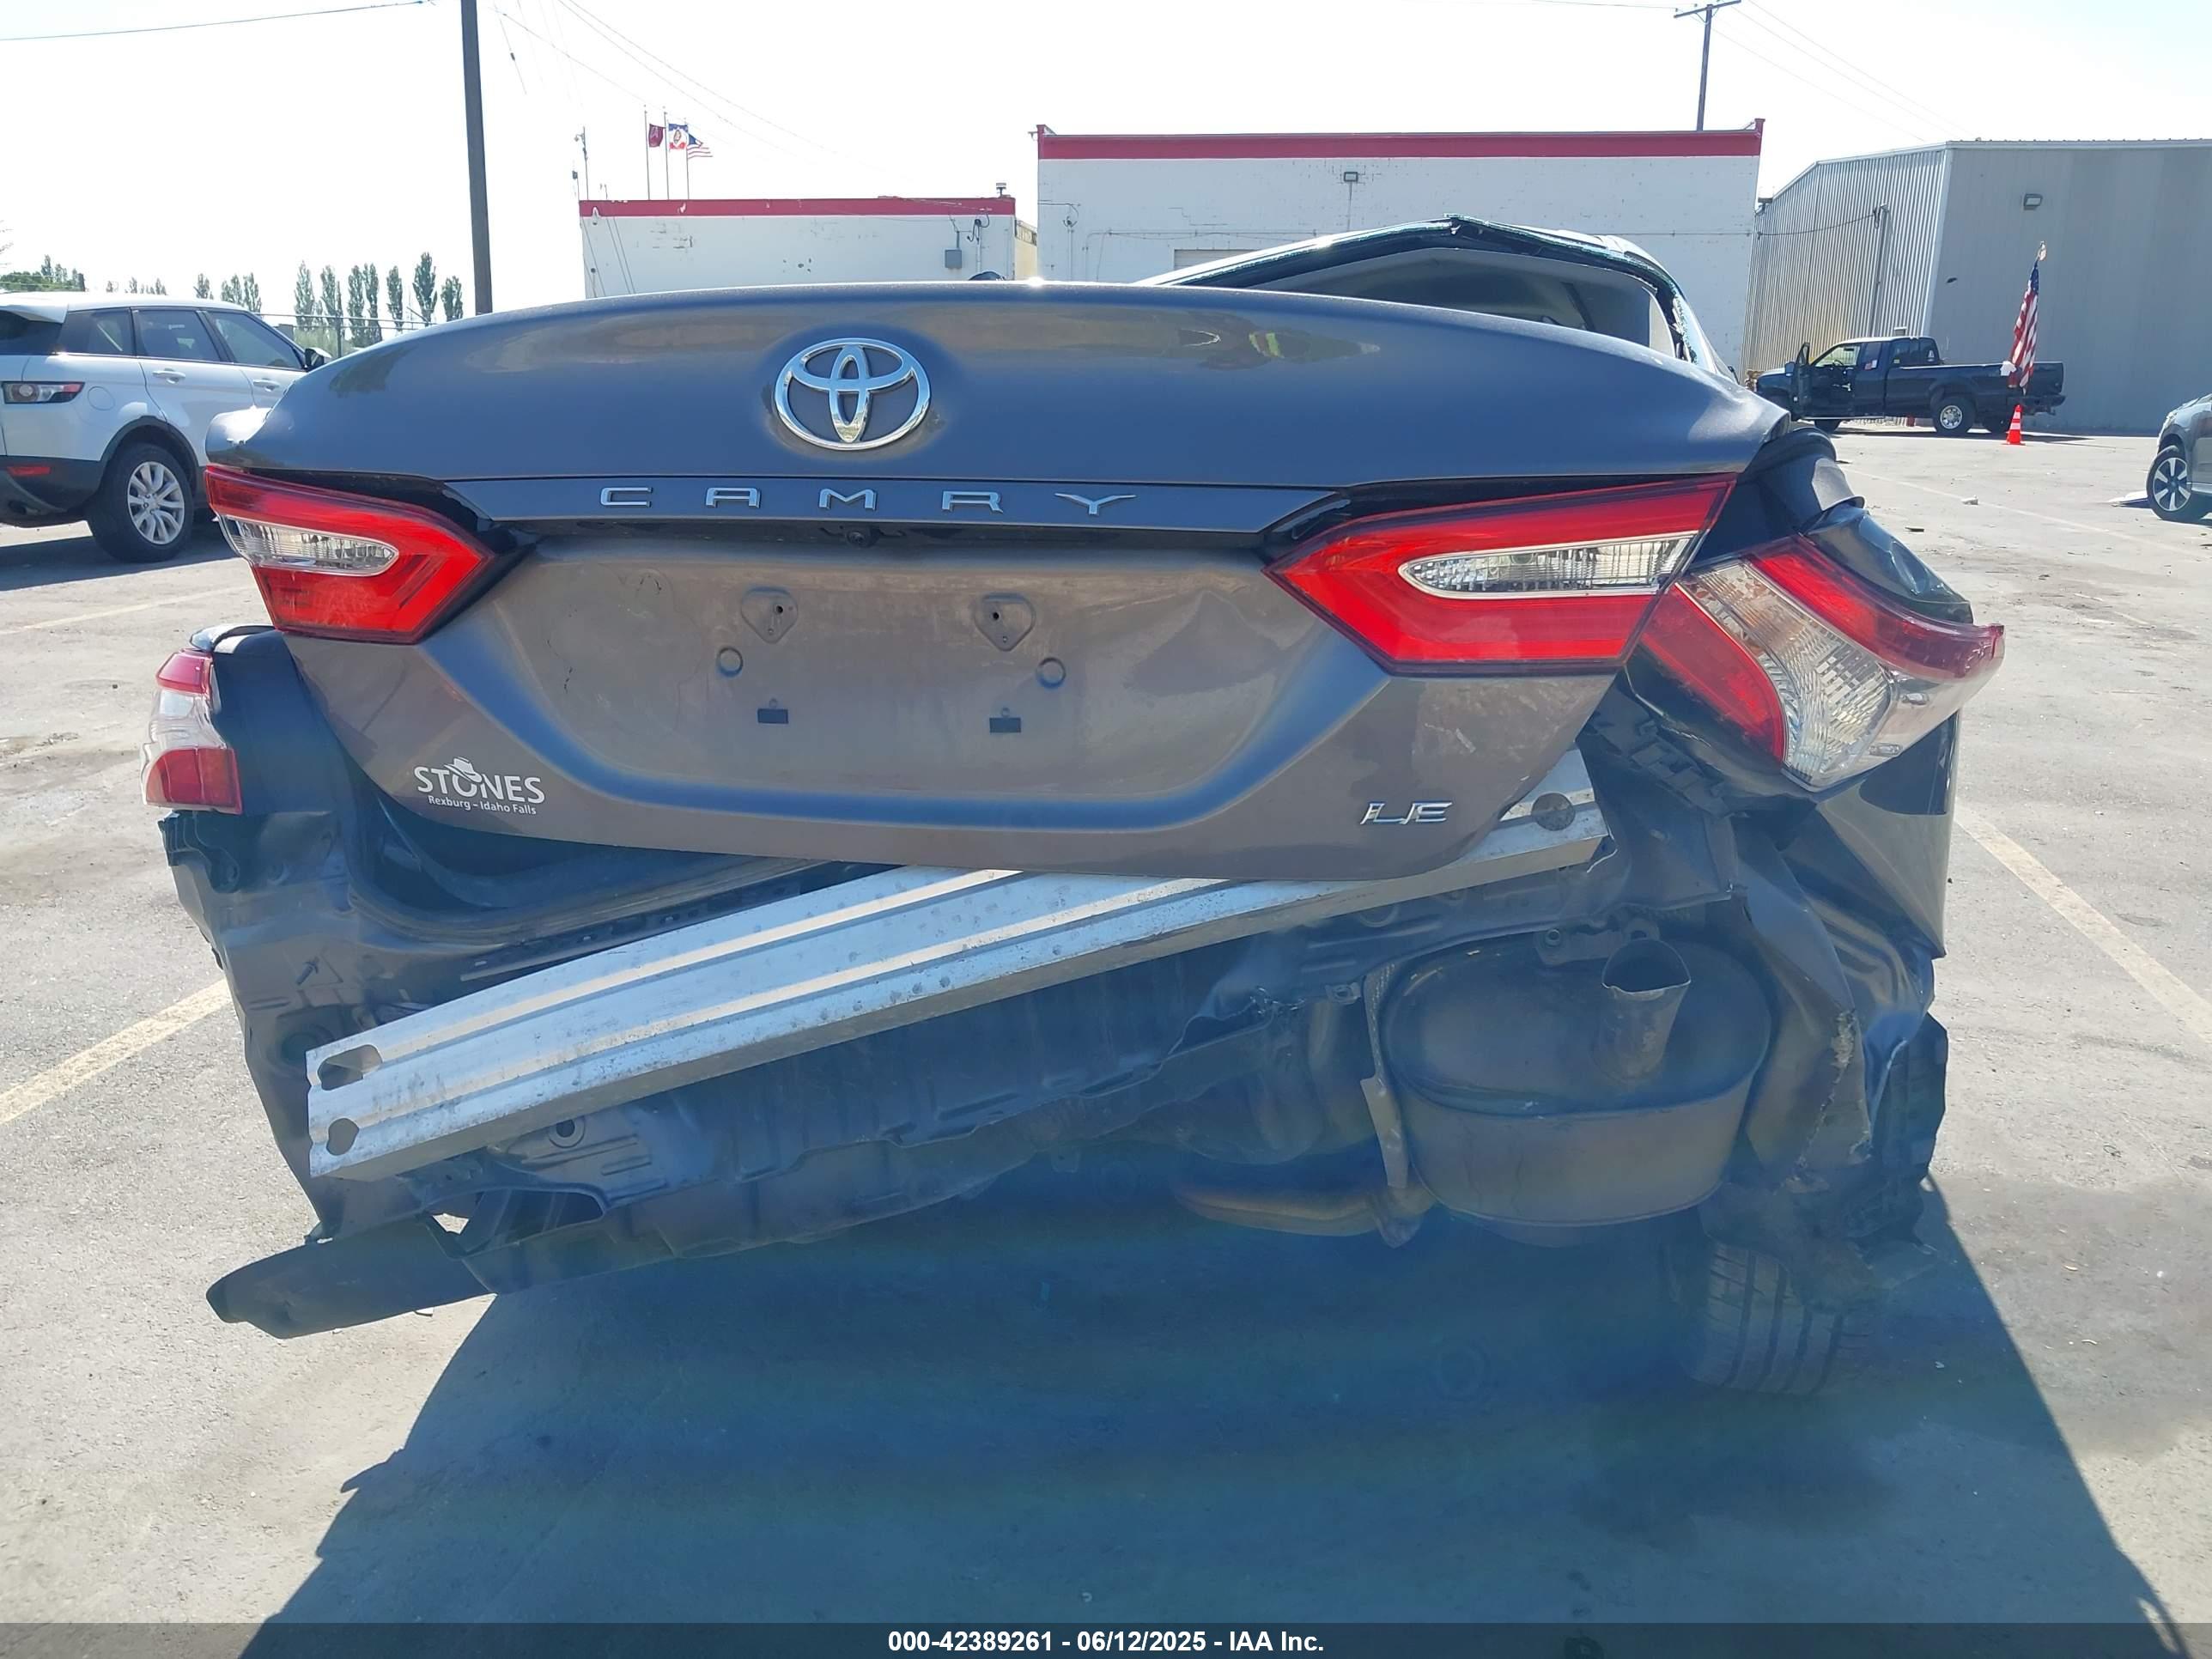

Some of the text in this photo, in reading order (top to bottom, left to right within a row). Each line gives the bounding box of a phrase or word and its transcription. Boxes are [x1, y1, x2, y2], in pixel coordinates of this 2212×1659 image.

[600, 486, 1138, 515] CAMRY
[414, 766, 545, 804] STONES
[428, 795, 471, 811] Rexburg
[480, 800, 510, 812] Idaho
[513, 804, 537, 815] Falls
[1359, 802, 1453, 825] LE
